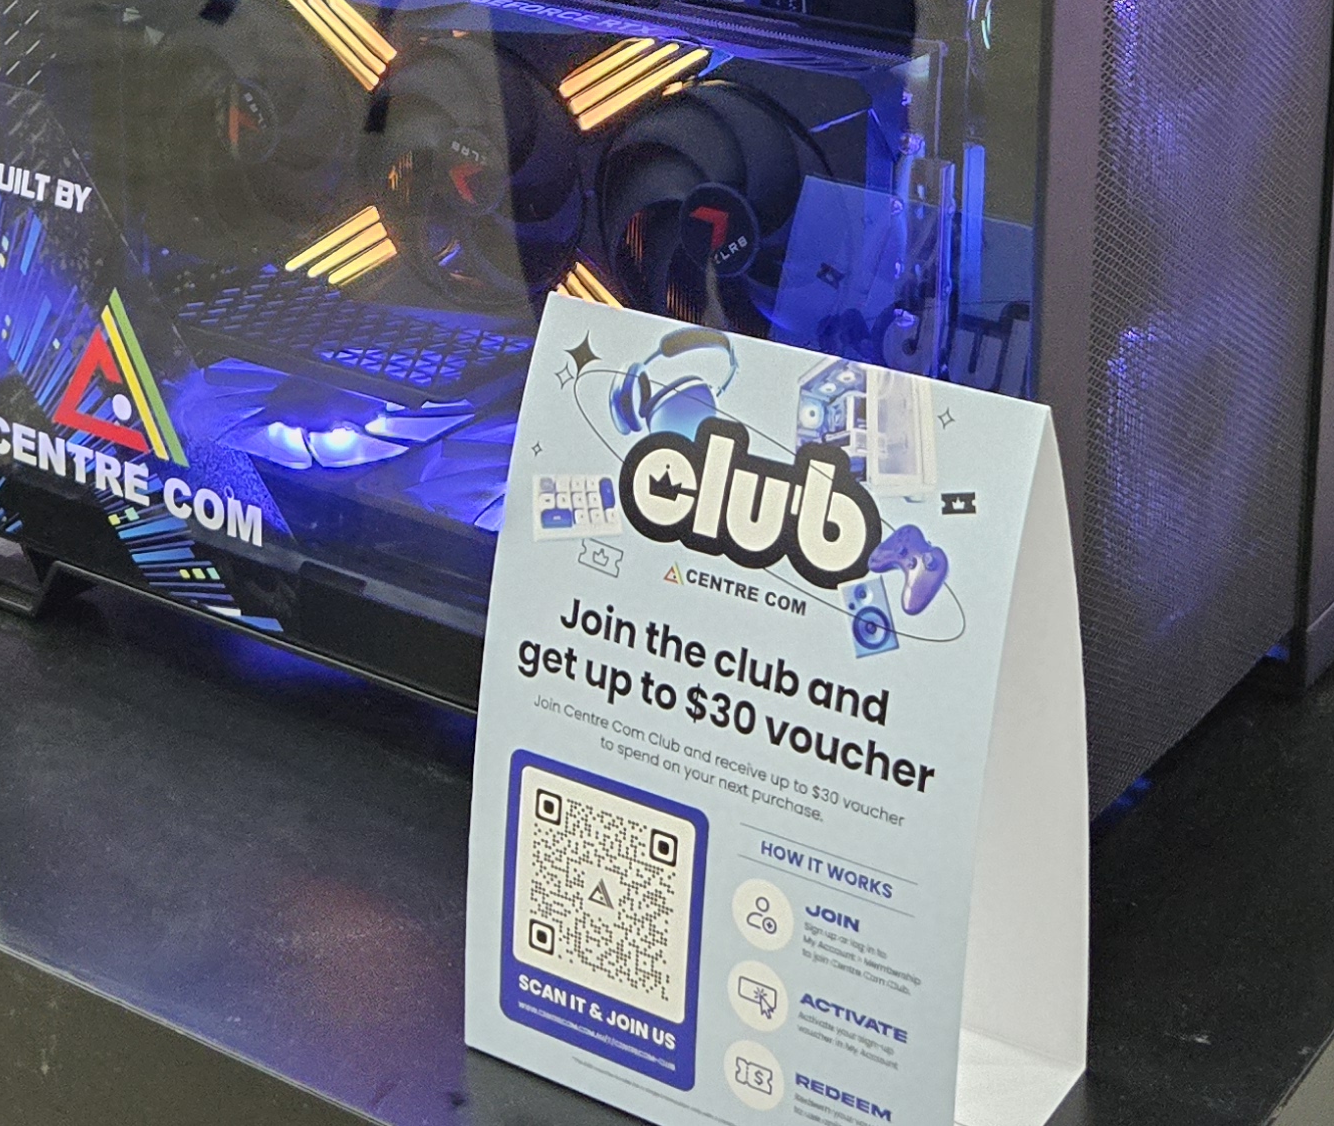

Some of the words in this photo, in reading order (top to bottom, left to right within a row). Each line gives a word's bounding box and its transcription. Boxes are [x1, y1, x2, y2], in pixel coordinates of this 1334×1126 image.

[604, 16, 654, 35] RTX
[55, 178, 92, 213] BY
[164, 478, 263, 547] COM
[631, 431, 868, 574] club
[686, 568, 759, 604] CENTRE
[764, 588, 807, 616] COM
[560, 598, 636, 649] Join
[646, 623, 707, 669] the
[714, 647, 800, 698] club
[808, 678, 890, 726] and
[518, 640, 578, 680] get
[585, 663, 632, 705] up
[641, 672, 677, 711] to
[685, 683, 756, 735] $30
[766, 713, 935, 793] voucher
[534, 694, 560, 715] Join
[563, 705, 609, 730] Centre
[612, 718, 645, 742] Com
[648, 729, 680, 753] Club
[684, 742, 712, 765] and
[715, 754, 767, 782] receive
[770, 772, 790, 792] up
[793, 777, 809, 795] to
[811, 783, 839, 807] $30
[842, 795, 905, 828] voucher
[600, 736, 614, 752] to
[617, 742, 660, 769] spend
[663, 757, 681, 774] on
[684, 764, 715, 788] your
[718, 776, 749, 798] next
[752, 785, 824, 823] purchase.
[761, 840, 805, 870] HOW
[809, 855, 824, 876] IT
[827, 862, 893, 899] WORKS
[805, 905, 860, 933] JOIN
[864, 957, 922, 987] Membership
[518, 973, 567, 1008] SCAN
[570, 996, 587, 1014] IT
[589, 1003, 603, 1022] &
[606, 1010, 648, 1040] JOIN
[653, 1031, 677, 1051] US
[800, 993, 908, 1044] ACTIVATE
[795, 1072, 892, 1123] REDEEM
